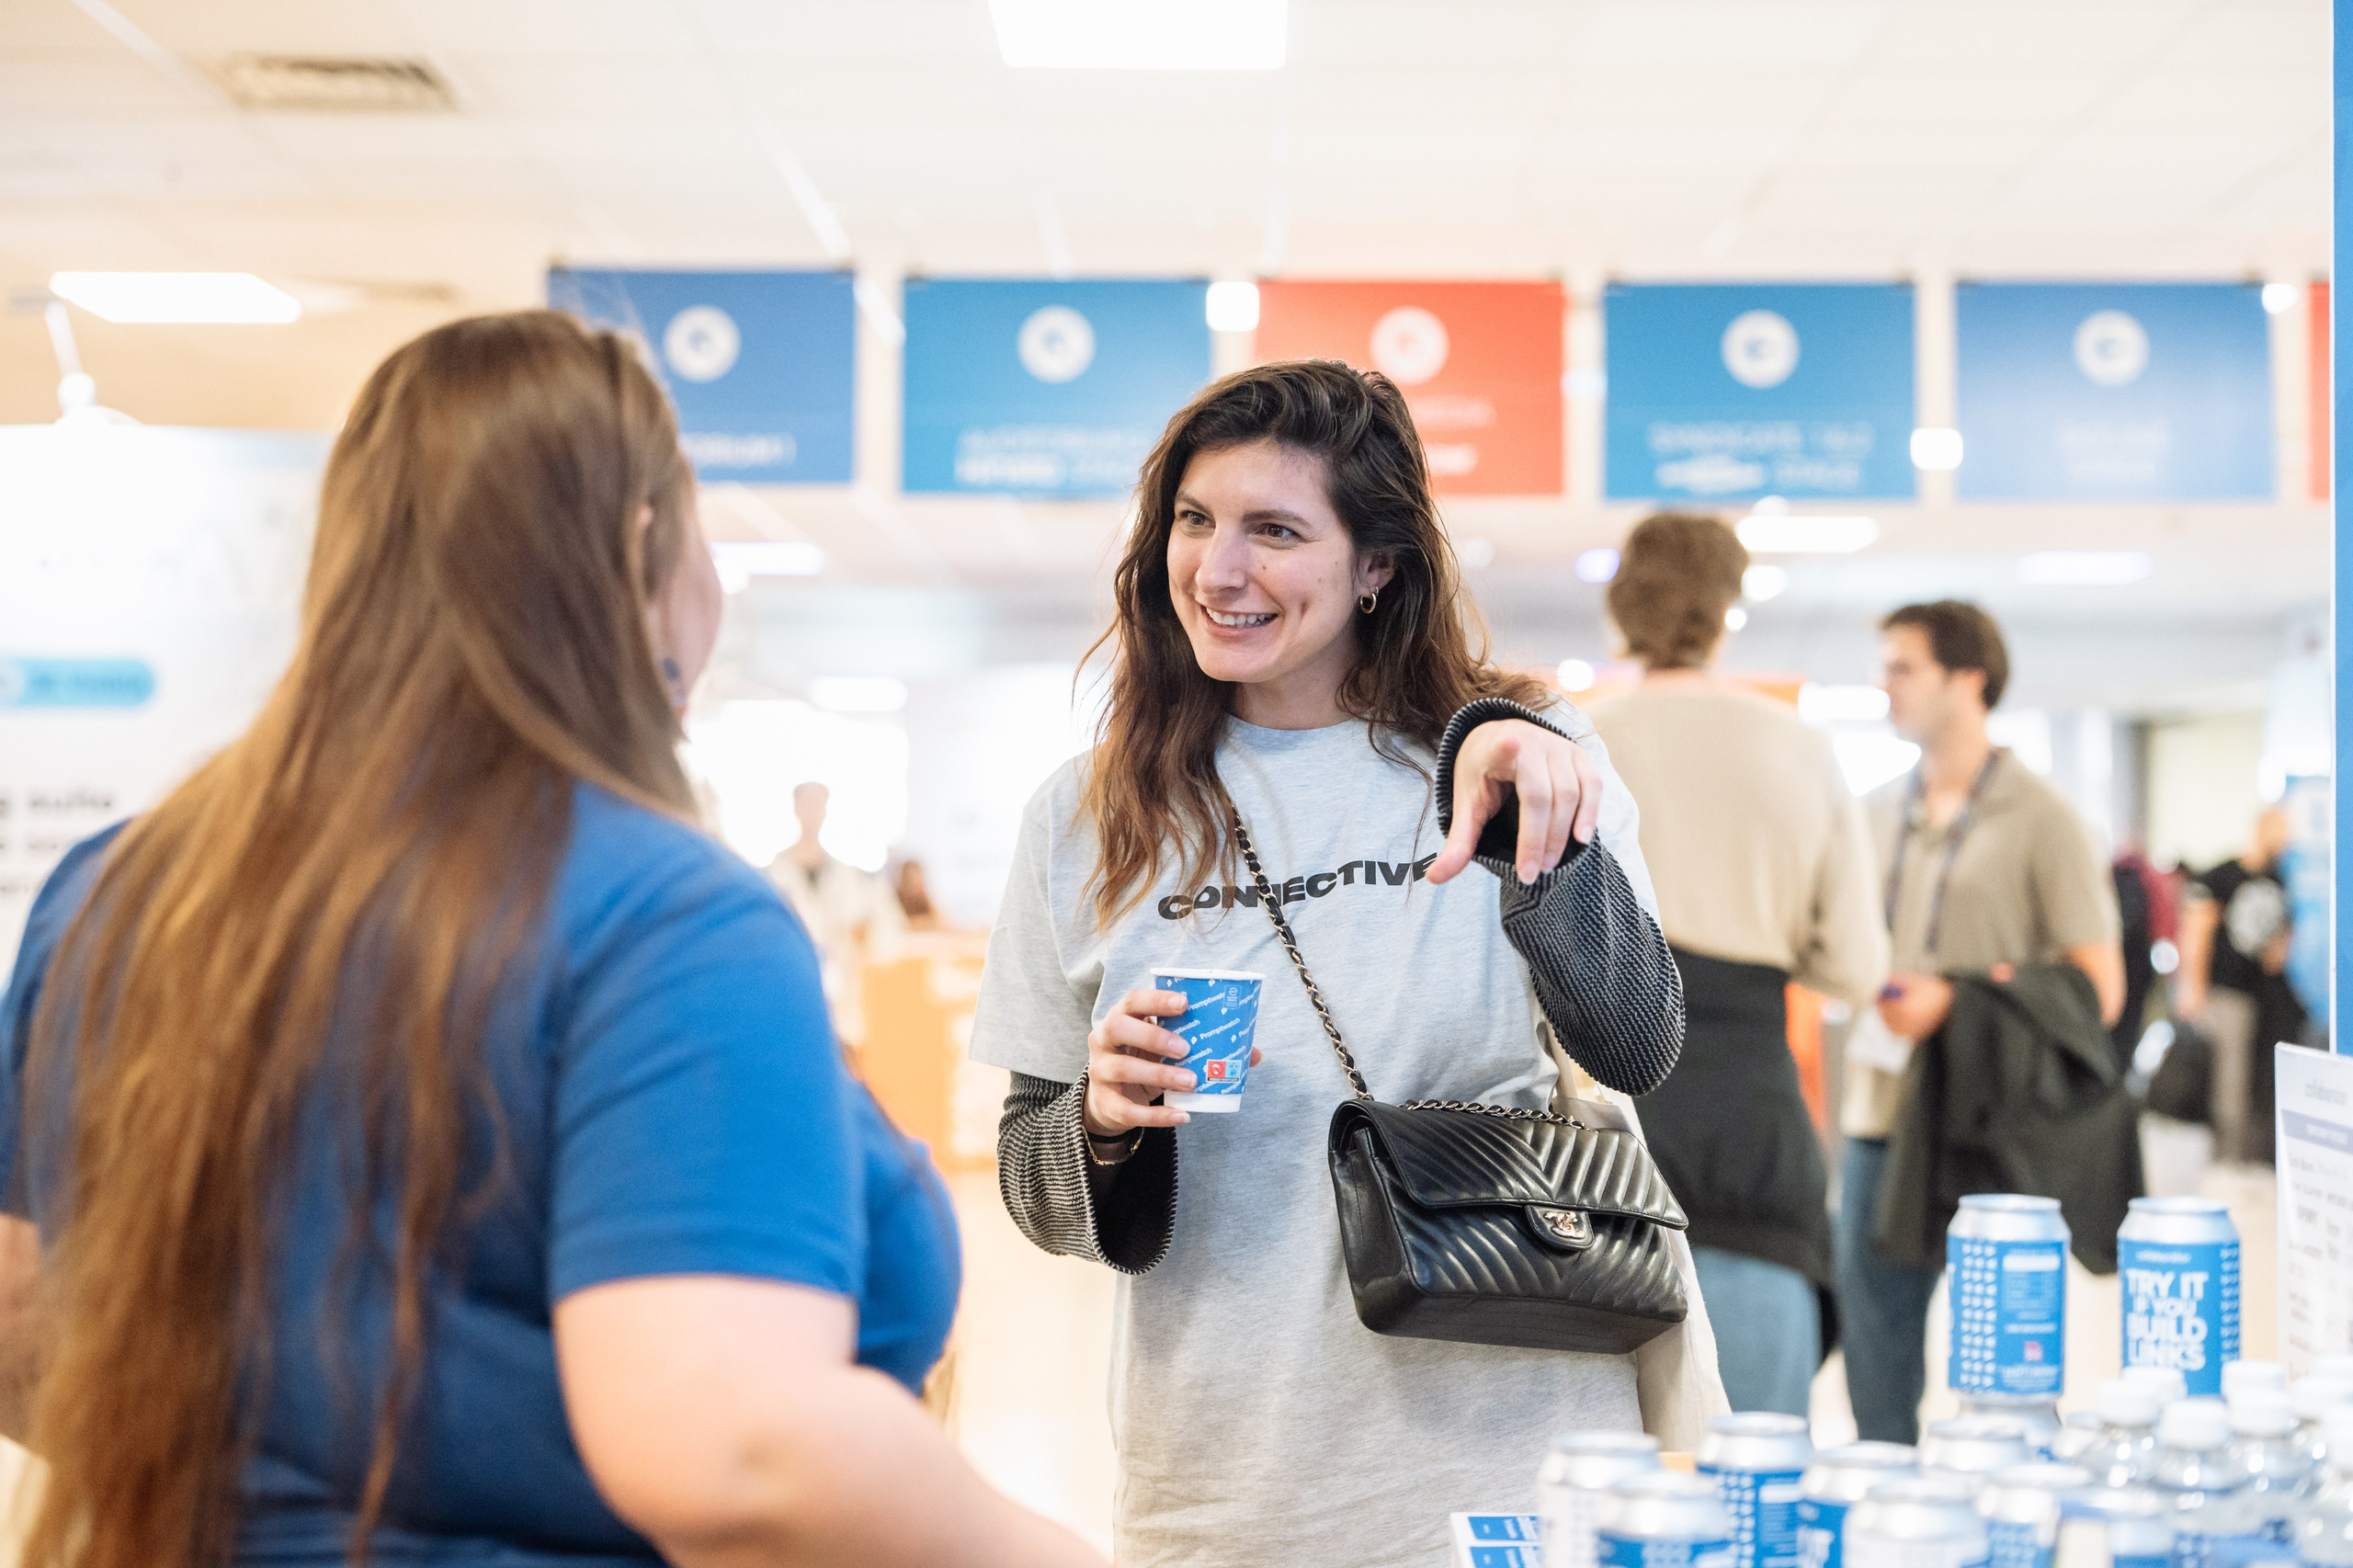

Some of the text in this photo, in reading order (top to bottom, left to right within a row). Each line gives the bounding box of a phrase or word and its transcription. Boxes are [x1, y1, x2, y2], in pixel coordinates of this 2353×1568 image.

[1199, 1017, 1241, 1040] Promptwatch
[2126, 1268, 2209, 1301] TRY IT
[2152, 1297, 2198, 1318] YOU
[2127, 1312, 2208, 1343] BUILD
[2128, 1340, 2206, 1371] LINKS
